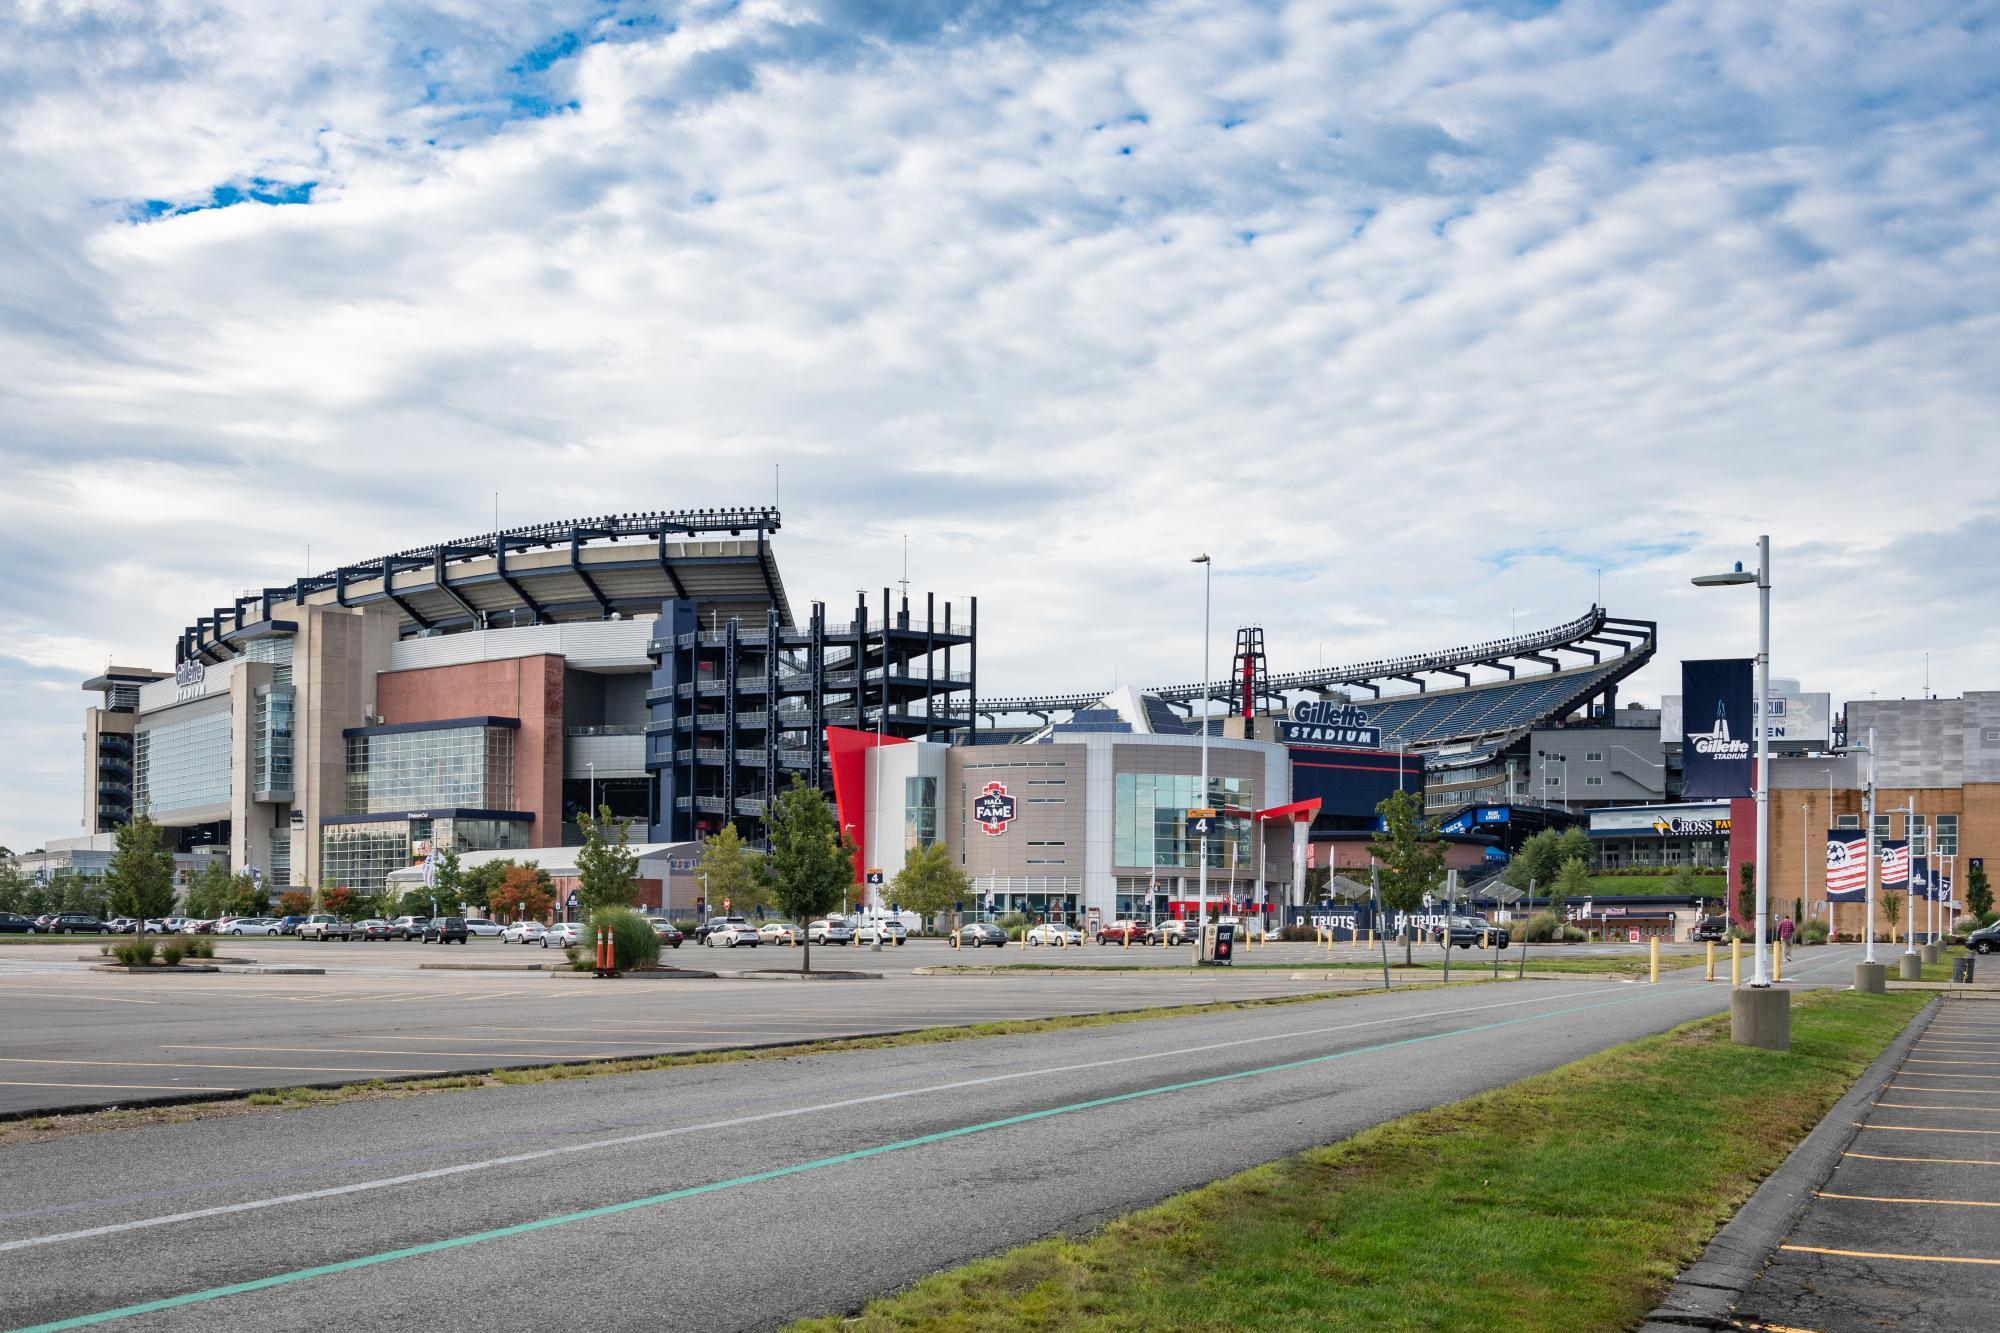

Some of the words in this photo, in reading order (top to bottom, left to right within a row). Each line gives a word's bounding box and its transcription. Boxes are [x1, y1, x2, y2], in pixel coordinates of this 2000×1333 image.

[176, 659, 205, 686] Gillette
[1292, 699, 1369, 728] Gillette
[1289, 727, 1371, 743] STADIUM
[1696, 739, 1749, 753] Gillette
[976, 806, 1012, 818] FAME
[1195, 818, 1208, 832] 4
[1445, 820, 1463, 833] DECK
[1670, 817, 1713, 832] CROSS
[871, 873, 879, 883] 4
[1296, 915, 1355, 929] PTRIOTS
